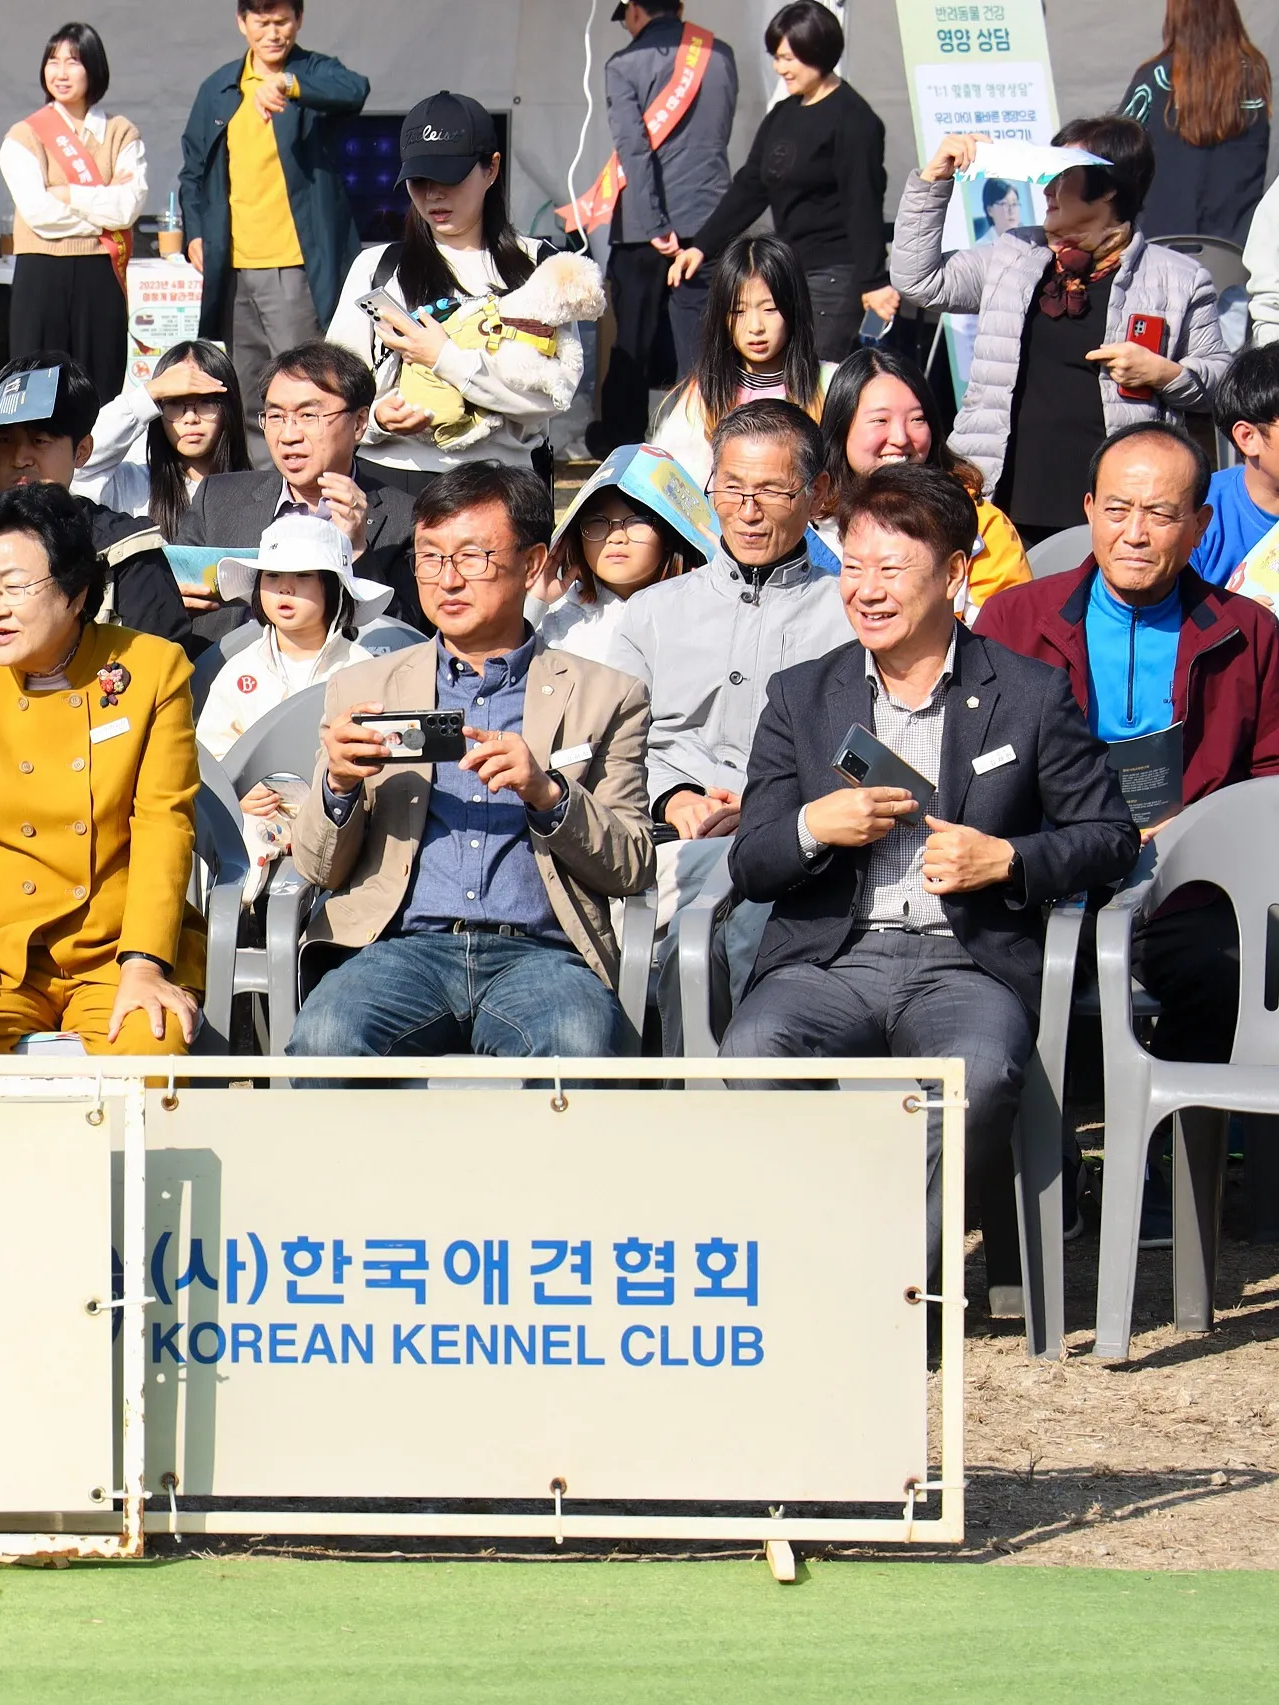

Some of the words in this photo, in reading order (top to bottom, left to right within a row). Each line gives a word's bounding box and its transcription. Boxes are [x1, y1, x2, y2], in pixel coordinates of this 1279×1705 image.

[935, 6, 980, 22] 반려동물
[983, 5, 1005, 21] 건강
[936, 28, 971, 53] 영양
[976, 27, 1011, 52] 상담
[951, 83, 982, 98] 맞춤형
[934, 111, 953, 125] 우리
[954, 111, 972, 124] 아이
[974, 110, 1000, 123] 올바른
[1001, 109, 1037, 123] 영양으로
[150, 1232, 759, 1307] (사)한국애견협회
[152, 1322, 374, 1364] KOREAN
[393, 1323, 606, 1366] KENNEL
[621, 1325, 764, 1367] CLUB
